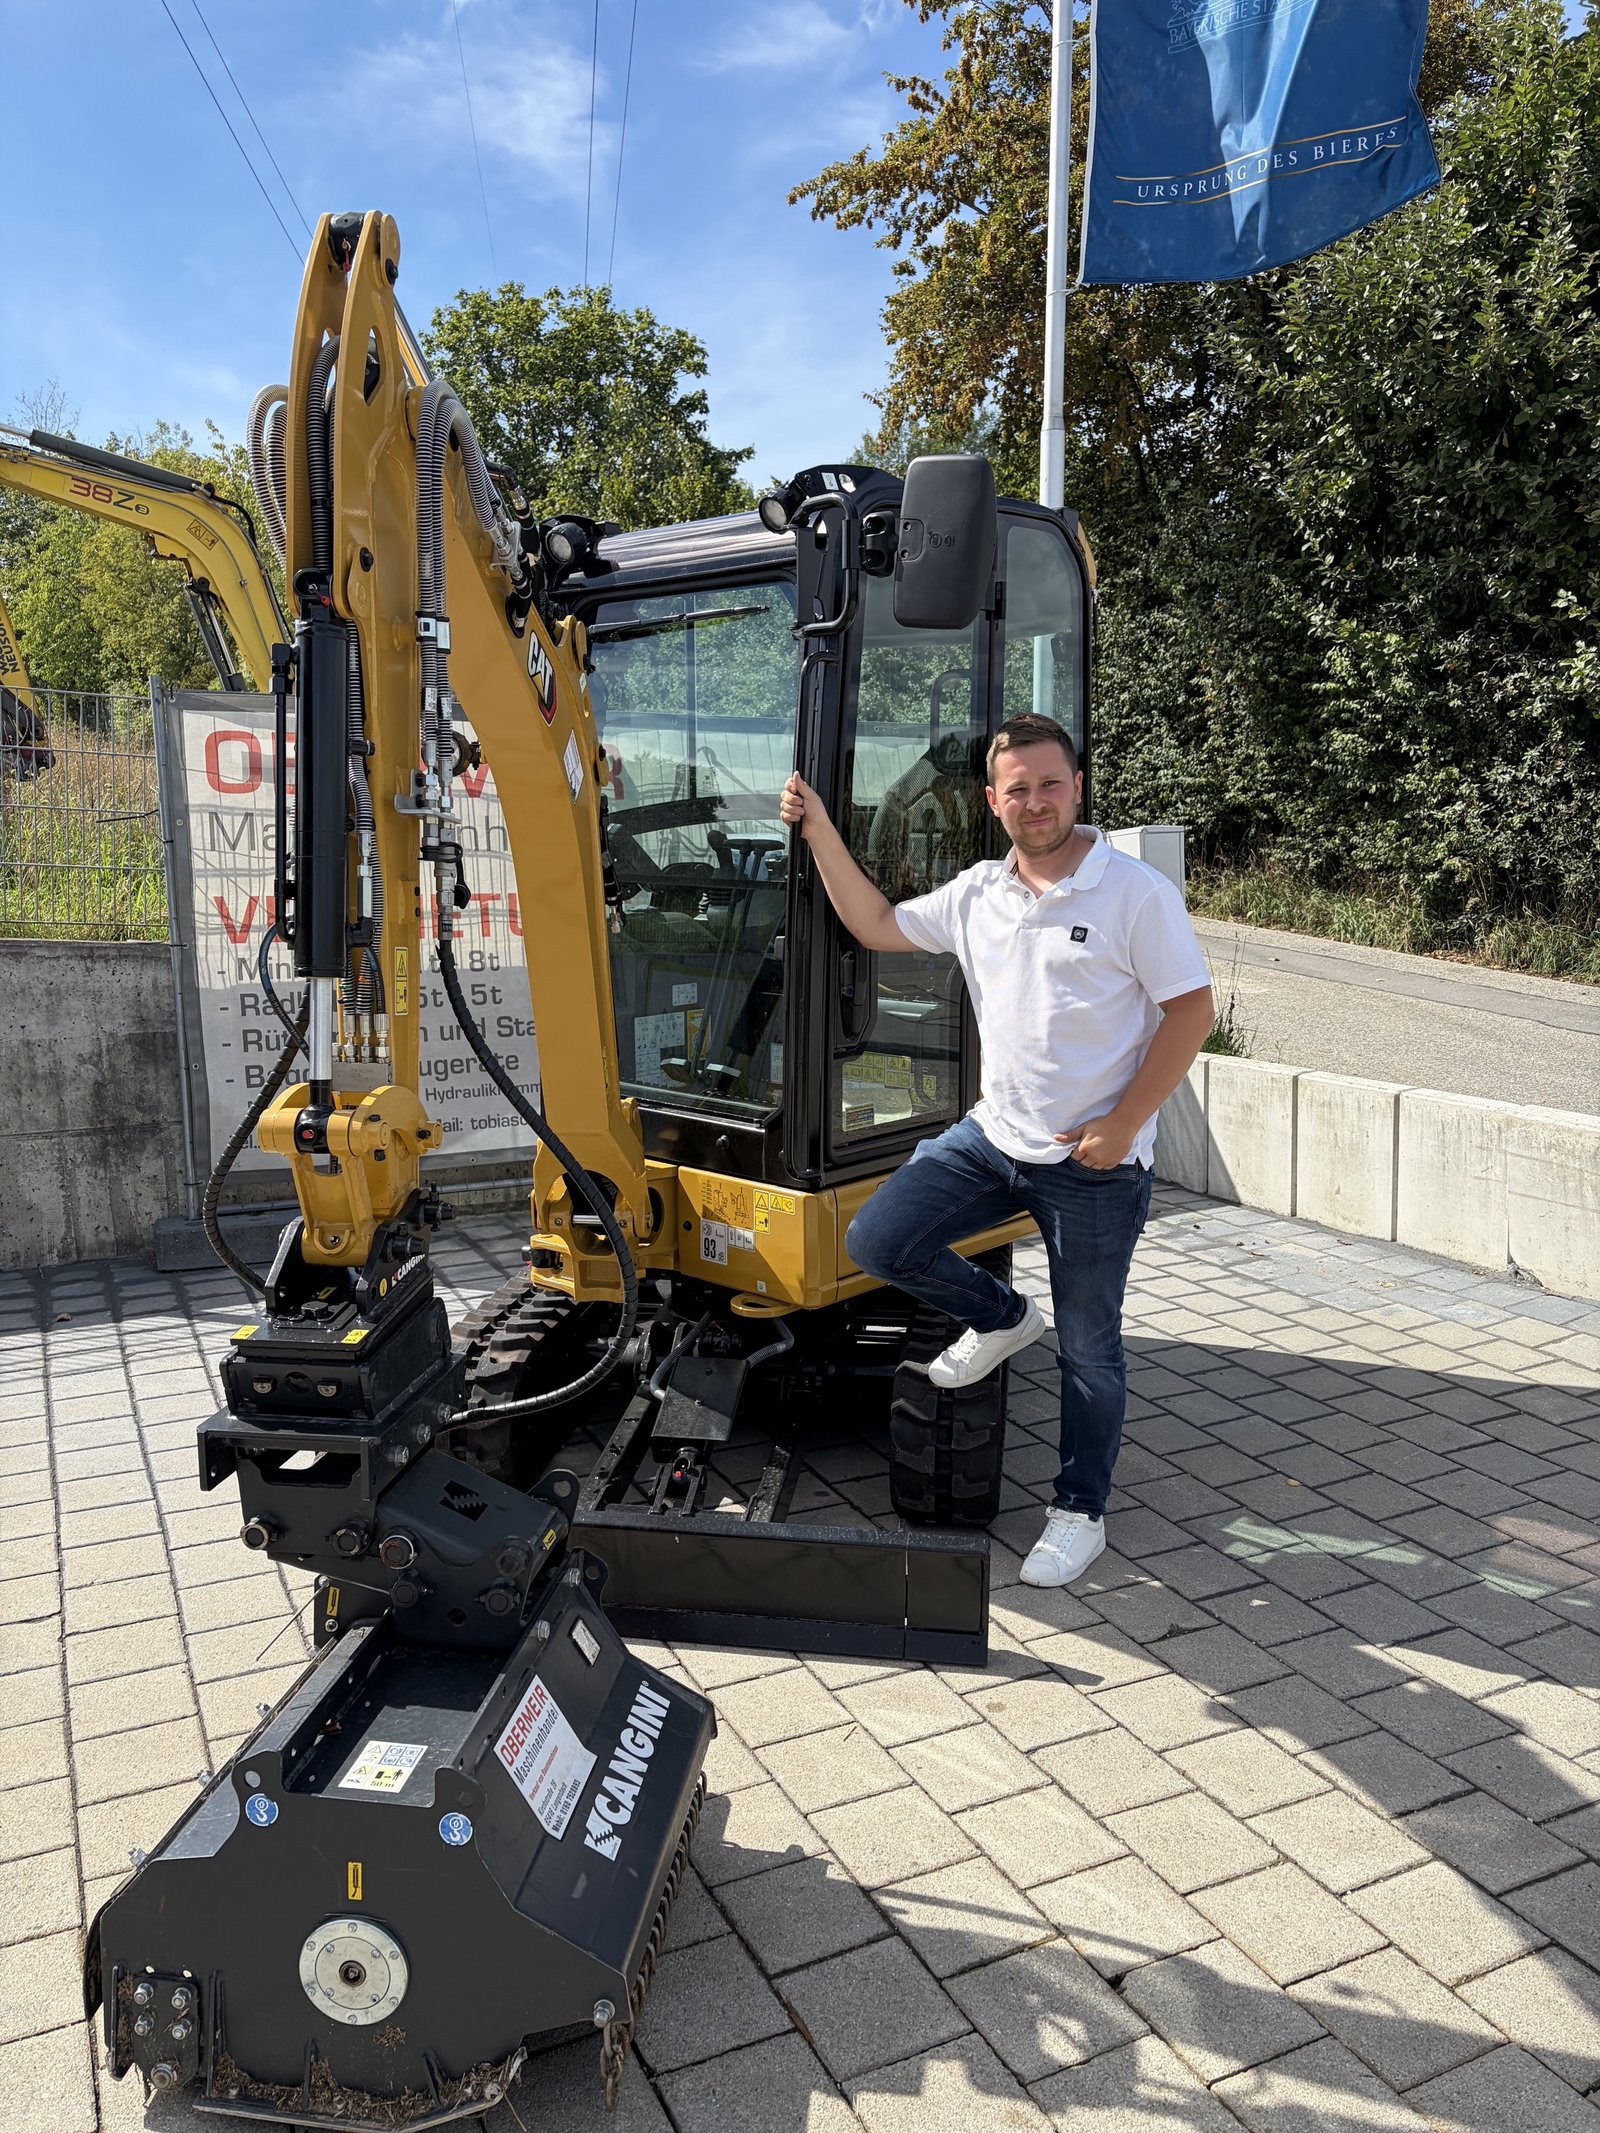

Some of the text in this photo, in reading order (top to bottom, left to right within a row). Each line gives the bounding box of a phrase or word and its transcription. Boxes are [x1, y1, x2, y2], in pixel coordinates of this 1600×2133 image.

[1169, 1, 1248, 44] BAYERISCHE
[1137, 126, 1398, 198] URSPRUNG DES BIERES
[528, 631, 554, 705] CAT
[469, 950, 500, 972] 8t
[471, 983, 502, 1006] 5t
[704, 1237, 716, 1258] 93
[500, 1684, 548, 1767] OBERMEIR
[513, 1702, 559, 1786] Maschinenhandel
[594, 1684, 671, 1826] CANGINI
